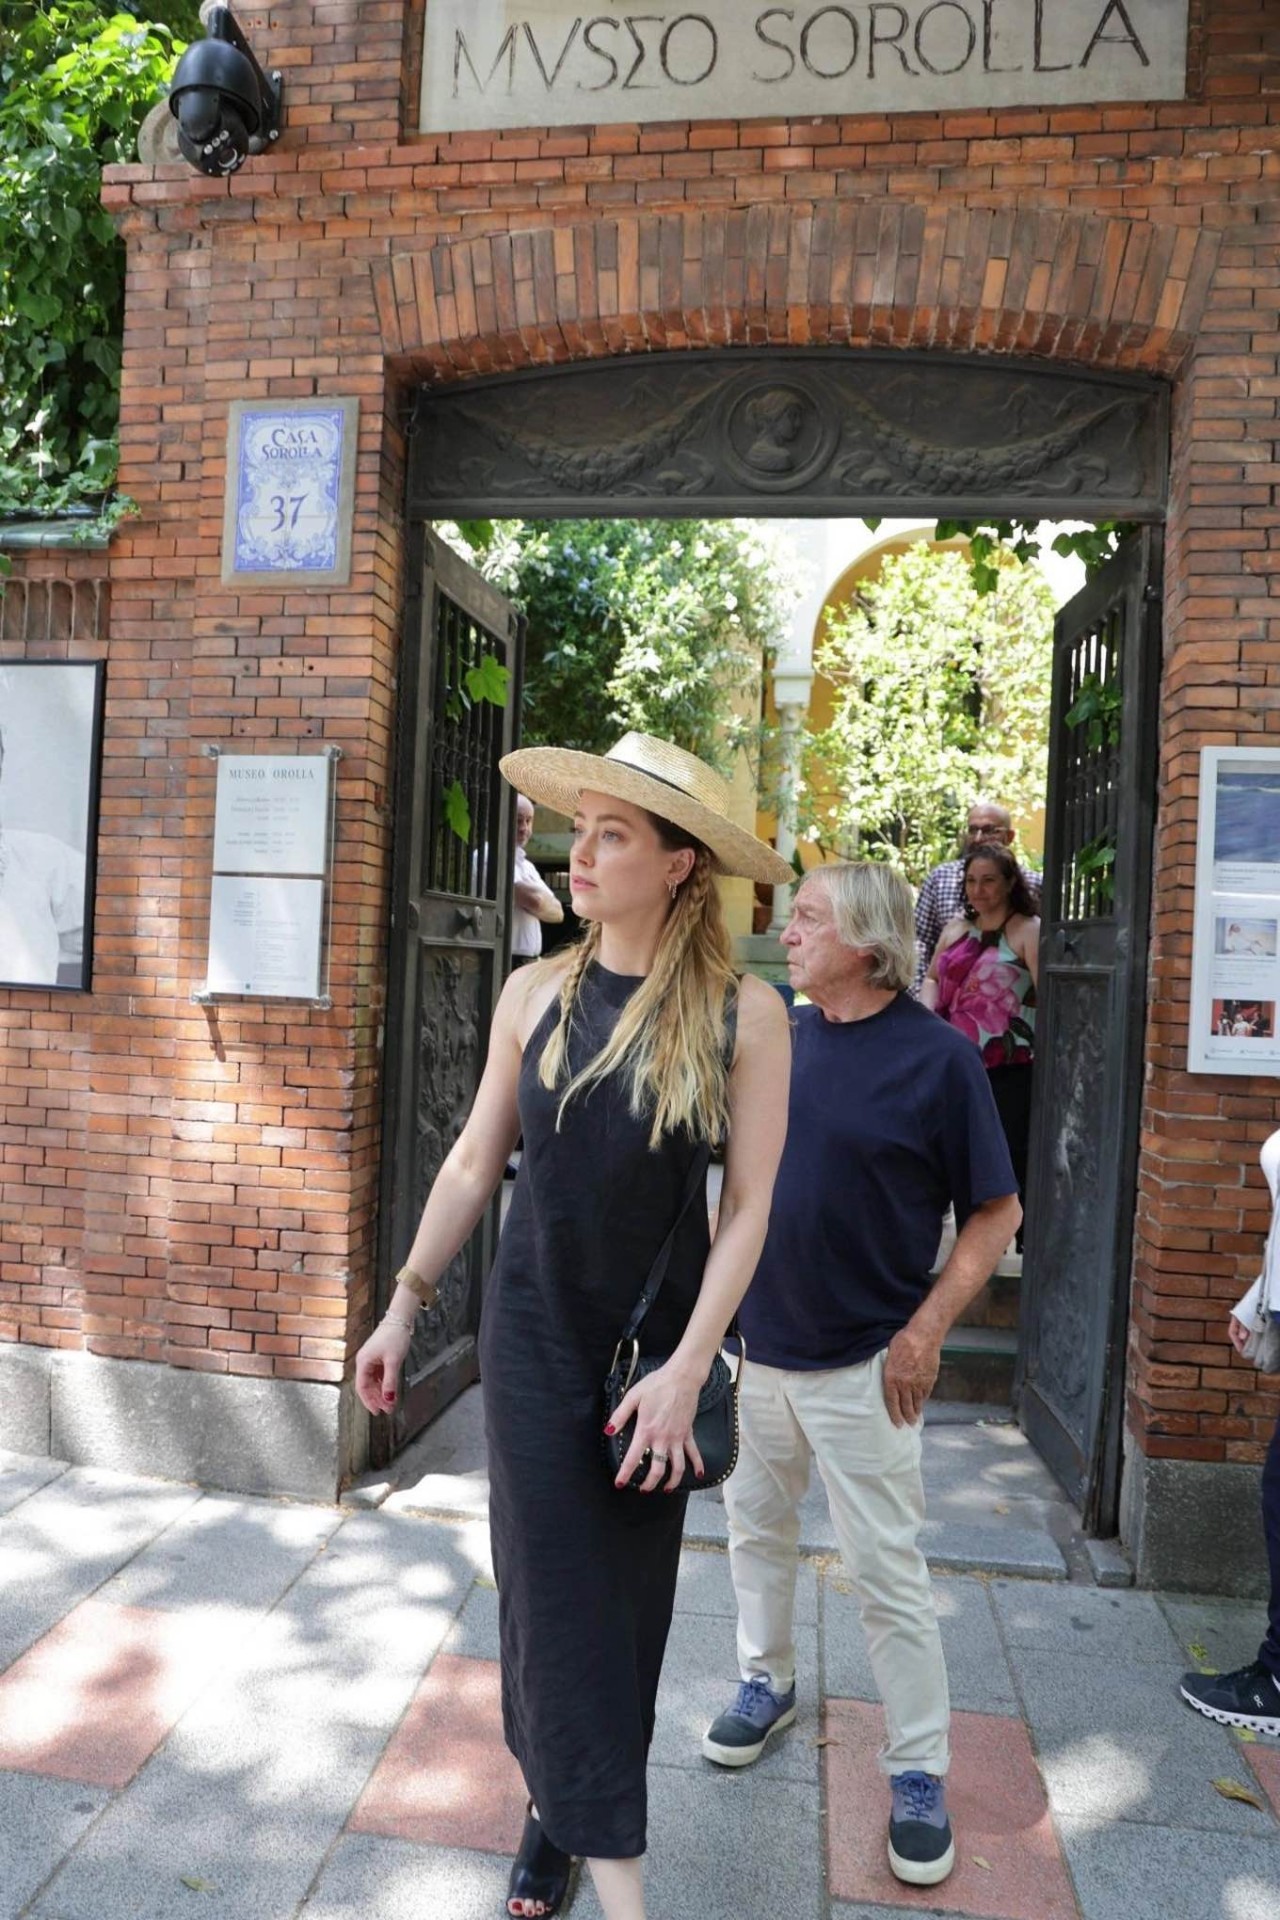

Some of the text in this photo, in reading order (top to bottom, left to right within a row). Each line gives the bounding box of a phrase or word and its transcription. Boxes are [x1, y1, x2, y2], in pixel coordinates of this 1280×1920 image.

[752, 0, 1150, 83] SOROLLA
[270, 493, 309, 532] 37
[229, 768, 266, 780] MUSEO
